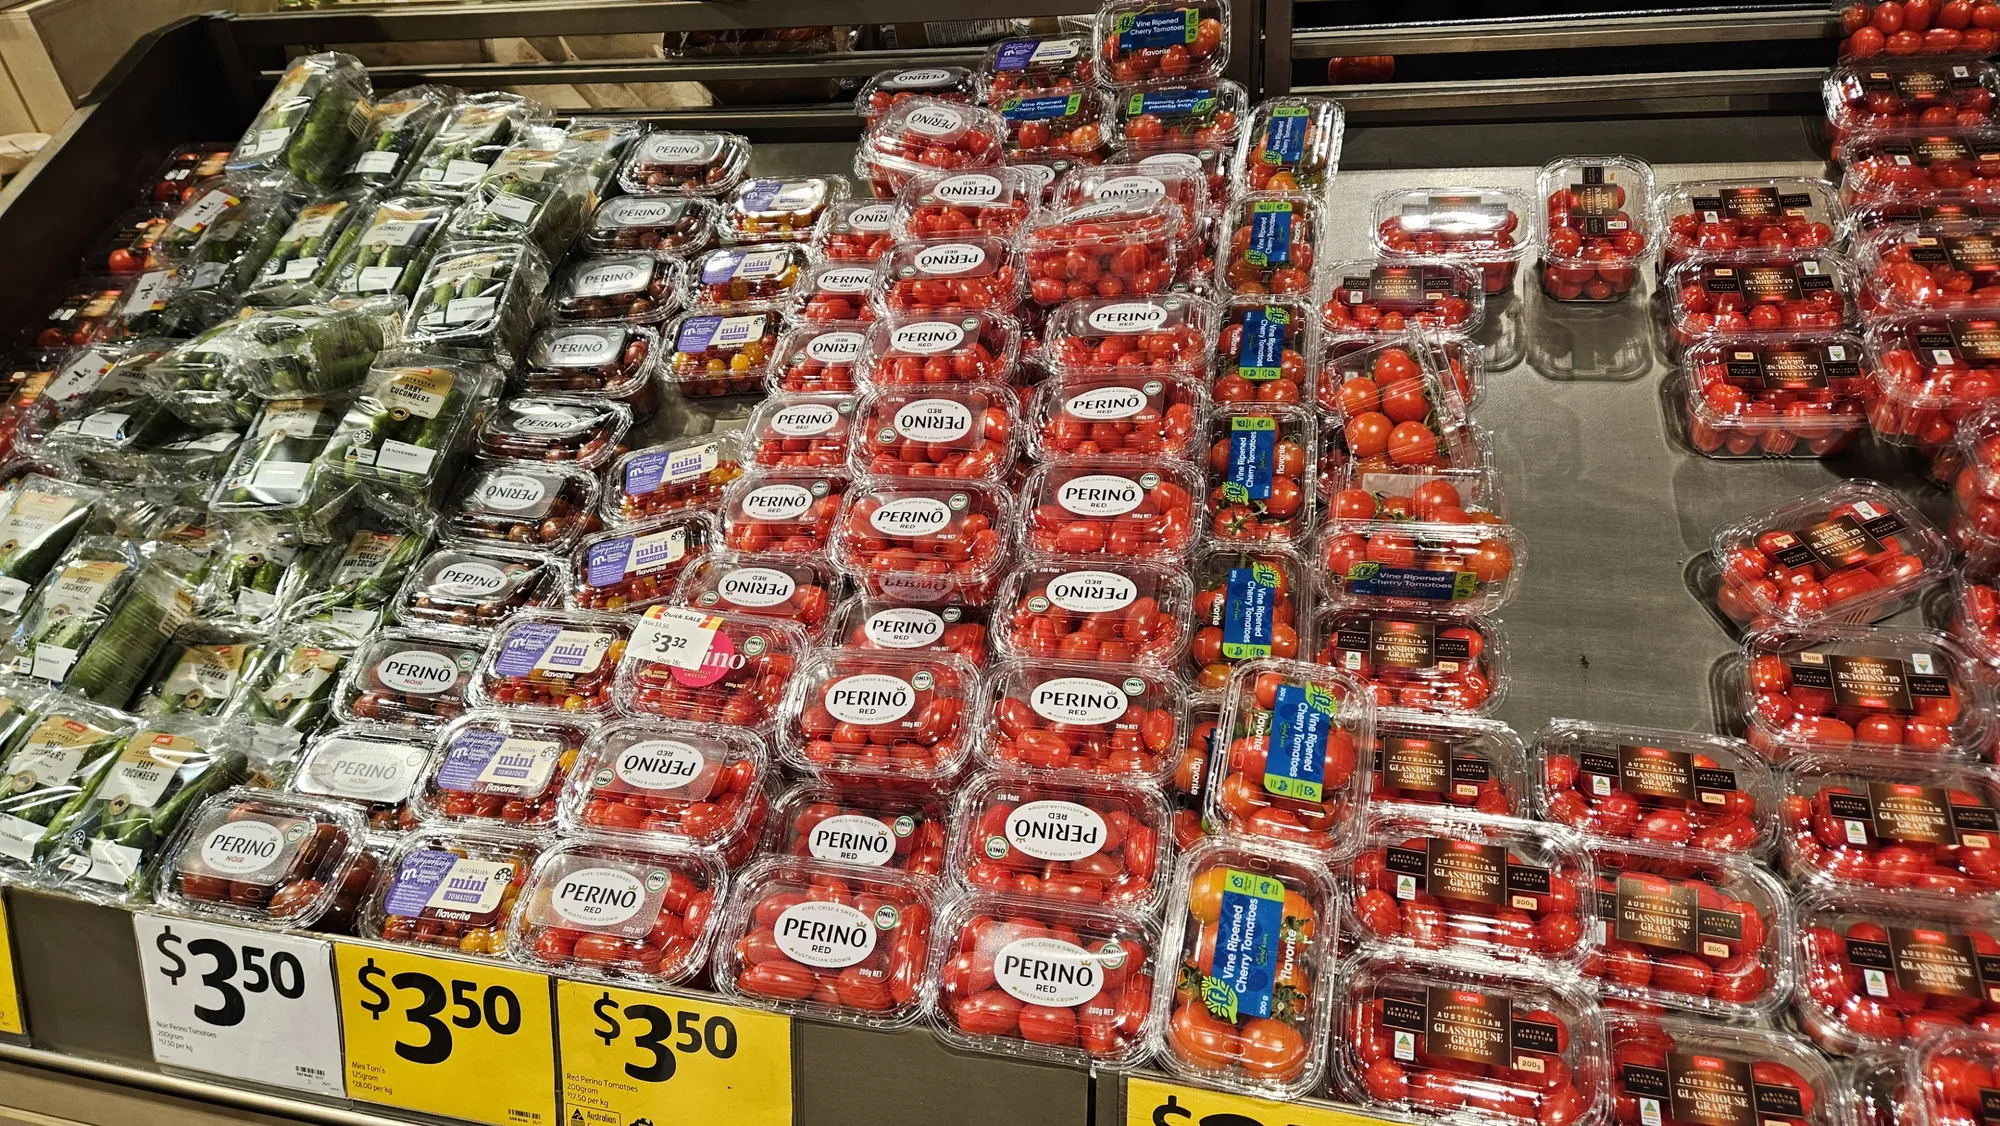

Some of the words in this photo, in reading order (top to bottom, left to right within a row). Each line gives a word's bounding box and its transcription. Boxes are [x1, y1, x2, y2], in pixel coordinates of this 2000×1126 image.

[1136, 19, 1150, 27] Vine
[1151, 17, 1179, 26] Ripened
[1130, 27, 1151, 36] Cherry
[1152, 24, 1185, 33] Tomatoes
[1142, 47, 1171, 56] flavorite
[721, 325, 750, 333] mini
[897, 330, 957, 342] PERINO
[390, 386, 430, 403] CUCUMBERS
[404, 384, 423, 393] BABY
[1073, 397, 1139, 409] PERINO
[777, 413, 833, 424] PERINO
[901, 415, 965, 430] PERINO
[391, 449, 418, 457] NOVEMBER
[1238, 437, 1246, 470] Ripened
[1247, 431, 1257, 462] Tomatoes
[671, 455, 702, 470] mini
[1276, 444, 1286, 475] flavorite
[671, 474, 701, 484] flavorite
[1237, 471, 1245, 483] Vine
[1245, 463, 1255, 488] Cherry
[749, 495, 805, 508] PERINO
[1066, 487, 1136, 502] PERINO
[878, 510, 943, 523] PERINO
[635, 541, 668, 558] mini
[636, 565, 667, 576] flavorite
[442, 569, 500, 588] PERINO
[726, 580, 788, 595] PERINO
[663, 611, 683, 619] Quick
[684, 614, 702, 623] SALE
[654, 621, 670, 629] $3.50
[872, 619, 937, 634] PERINO
[1378, 636, 1427, 644] AUSTRALIAN
[1376, 644, 1429, 654] GLASSHOUSE
[1388, 651, 1416, 659] GRAPE
[656, 655, 672, 665] Save
[385, 661, 450, 682] PERINO
[833, 690, 906, 707] PERINO
[1040, 691, 1118, 709] PERINO
[1294, 702, 1308, 733] Cherry
[1310, 713, 1321, 733] Vine
[1253, 712, 1269, 751] flavorite
[1290, 735, 1303, 778] Tomatoes
[1304, 733, 1318, 773] Ripened
[136, 760, 154, 771] BABY
[498, 753, 535, 768] mini
[1627, 761, 1685, 773] AUSTRALIAN
[122, 768, 160, 781] CUCUMBERS
[497, 769, 525, 777] TOMATOES
[1190, 757, 1203, 796] flavorite
[1626, 770, 1688, 784] GLASSHOUSE
[485, 782, 520, 793] flavorite
[1015, 819, 1098, 844] PERINO
[209, 833, 275, 858] PERINO
[816, 830, 888, 853] PERINO
[225, 855, 244, 864] NOIR
[840, 852, 858, 860] RED
[1437, 858, 1497, 872] AUSTRALIAN
[448, 875, 488, 891] mini
[1434, 868, 1500, 886] GLASSHOUSE
[560, 882, 636, 908] PERINO
[1447, 886, 1486, 896] TOMATOES
[1648, 884, 1667, 892] coles
[446, 892, 476, 902] TOMATOES
[435, 908, 471, 921] flavorite
[583, 905, 602, 914] RED
[841, 909, 858, 918] SWEET
[878, 911, 895, 919] ONLY
[1627, 901, 1688, 915] AUSTRALIAN
[1624, 911, 1690, 930] GLASSHOUSE
[783, 917, 867, 947] PERINO
[1227, 905, 1244, 951] Ripened
[811, 944, 832, 955] RED
[1235, 955, 1252, 993] Cherry
[1244, 898, 1259, 955] Tomatoes
[794, 951, 828, 962] AUSTRALIAN
[1280, 929, 1297, 980] flavorite
[1004, 955, 1093, 987] PERINO
[1223, 952, 1235, 979] Vine
[1018, 989, 1055, 1002] AUSTRALIAN
[1035, 984, 1057, 994] RED
[1458, 994, 1479, 1003] coles
[1088, 1006, 1102, 1015] 200g
[1103, 1008, 1115, 1016] NET
[1437, 1011, 1501, 1027] AUSTRALIAN
[156, 1020, 169, 1031] Noir
[169, 1022, 188, 1034] Perino
[188, 1025, 217, 1039] Tomatoes
[157, 1029, 184, 1042] 200gram
[1433, 1023, 1504, 1043] GLASSHOUSE
[158, 1037, 175, 1049] $17.50
[176, 1042, 185, 1051] per
[185, 1043, 193, 1053] kg
[1446, 1044, 1490, 1056] TOMATOES
[351, 1060, 367, 1070] Mini
[368, 1062, 385, 1074] Tom's
[1521, 1059, 1541, 1070] 200g
[352, 1070, 378, 1082] 125gram
[566, 1072, 579, 1083] Red
[580, 1075, 601, 1086] Perino
[604, 1079, 639, 1094] Tomatoes
[352, 1079, 372, 1090] $28.00
[372, 1083, 382, 1092] per
[383, 1084, 392, 1095] kg
[567, 1082, 600, 1095] 200gram
[1679, 1076, 1744, 1091] AUSTRALIAN
[567, 1091, 588, 1103] $17.50
[588, 1095, 600, 1105] per
[600, 1097, 609, 1108] kg
[1677, 1089, 1748, 1108] GLASSHOUSE
[587, 1110, 618, 1125] Australian
